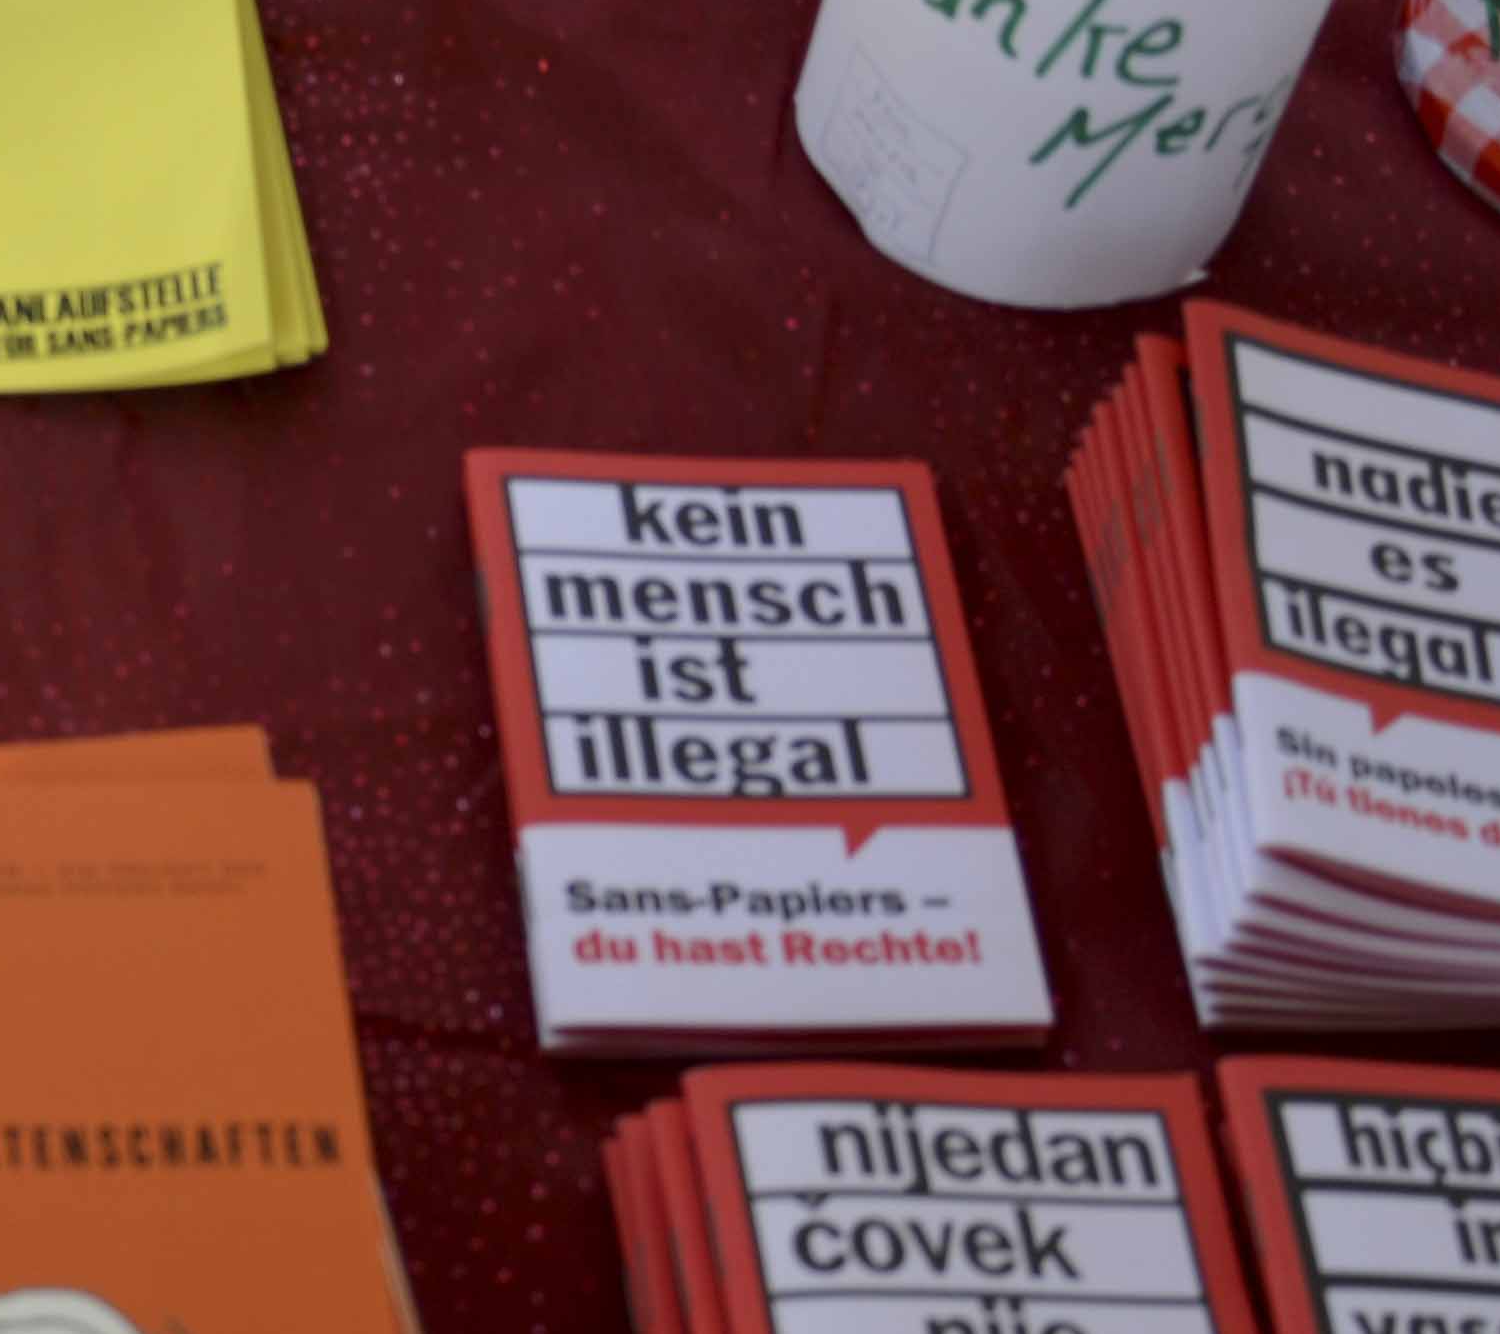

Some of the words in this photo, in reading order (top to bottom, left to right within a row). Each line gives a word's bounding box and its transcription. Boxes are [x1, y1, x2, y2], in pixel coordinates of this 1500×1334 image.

[45, 321, 115, 353] SANS
[123, 302, 228, 348] PAPIERS
[618, 482, 806, 548] kein
[543, 559, 906, 628] mensch
[1369, 540, 1461, 594] es
[1284, 581, 1496, 687] ilegal
[635, 637, 757, 705] ist
[572, 716, 872, 798] illegal
[1273, 727, 1338, 769] Sin
[1348, 778, 1472, 842] tienes
[565, 881, 908, 924] Sans-Papiers
[573, 931, 623, 966] du
[652, 931, 768, 966] hast
[781, 930, 983, 967] Rechte!
[818, 1103, 1160, 1191] nijedan
